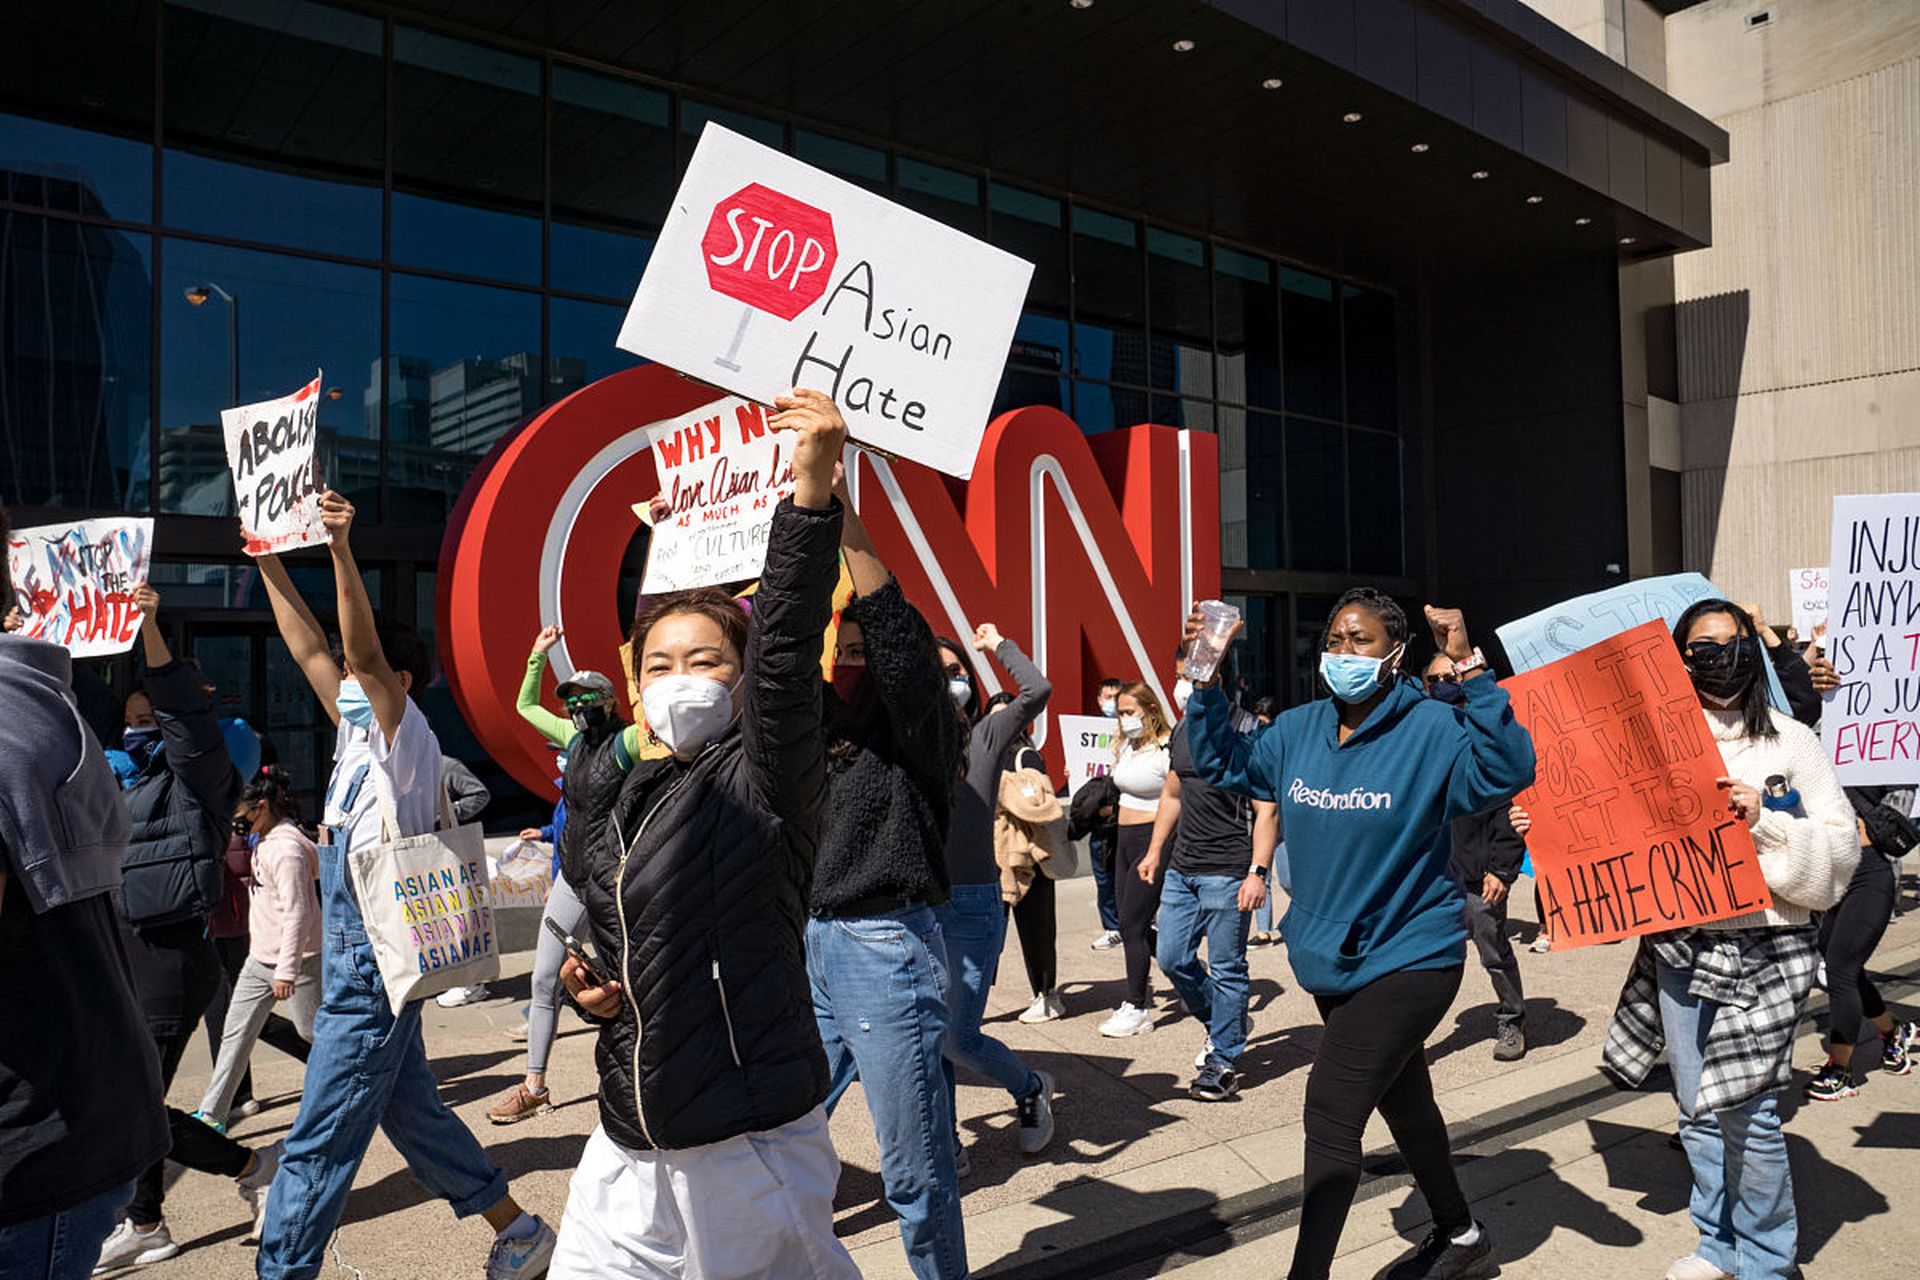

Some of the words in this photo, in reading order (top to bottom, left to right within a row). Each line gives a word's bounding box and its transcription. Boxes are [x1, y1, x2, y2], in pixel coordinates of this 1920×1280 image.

[709, 207, 826, 291] STOP
[822, 260, 953, 361] Asian
[790, 331, 927, 432] Hate
[657, 415, 721, 470] WHY
[710, 456, 759, 505] Asian
[676, 513, 691, 528] AS
[703, 503, 740, 522] MUCH
[753, 495, 768, 511] AS
[79, 539, 114, 577] STOP
[101, 571, 129, 593] THE
[64, 583, 141, 646] HATE
[1594, 634, 1670, 716] IT
[1833, 633, 1856, 677] IS
[1868, 632, 1893, 674] A
[1840, 680, 1872, 717] TO
[1591, 695, 1704, 780] WHAT
[1287, 777, 1392, 810] Restoration
[1553, 787, 1620, 855] IT
[393, 866, 456, 901] ASIAN
[459, 861, 478, 885] AF
[402, 888, 463, 925] ASIAN
[465, 882, 485, 908] AF
[1548, 873, 1572, 943] A
[1566, 851, 1653, 937] HATE
[1649, 820, 1765, 921] CRIME.
[409, 912, 468, 948] ASIAN
[469, 906, 490, 930] AF
[417, 935, 470, 975] ASIAN
[471, 931, 492, 957] AF
